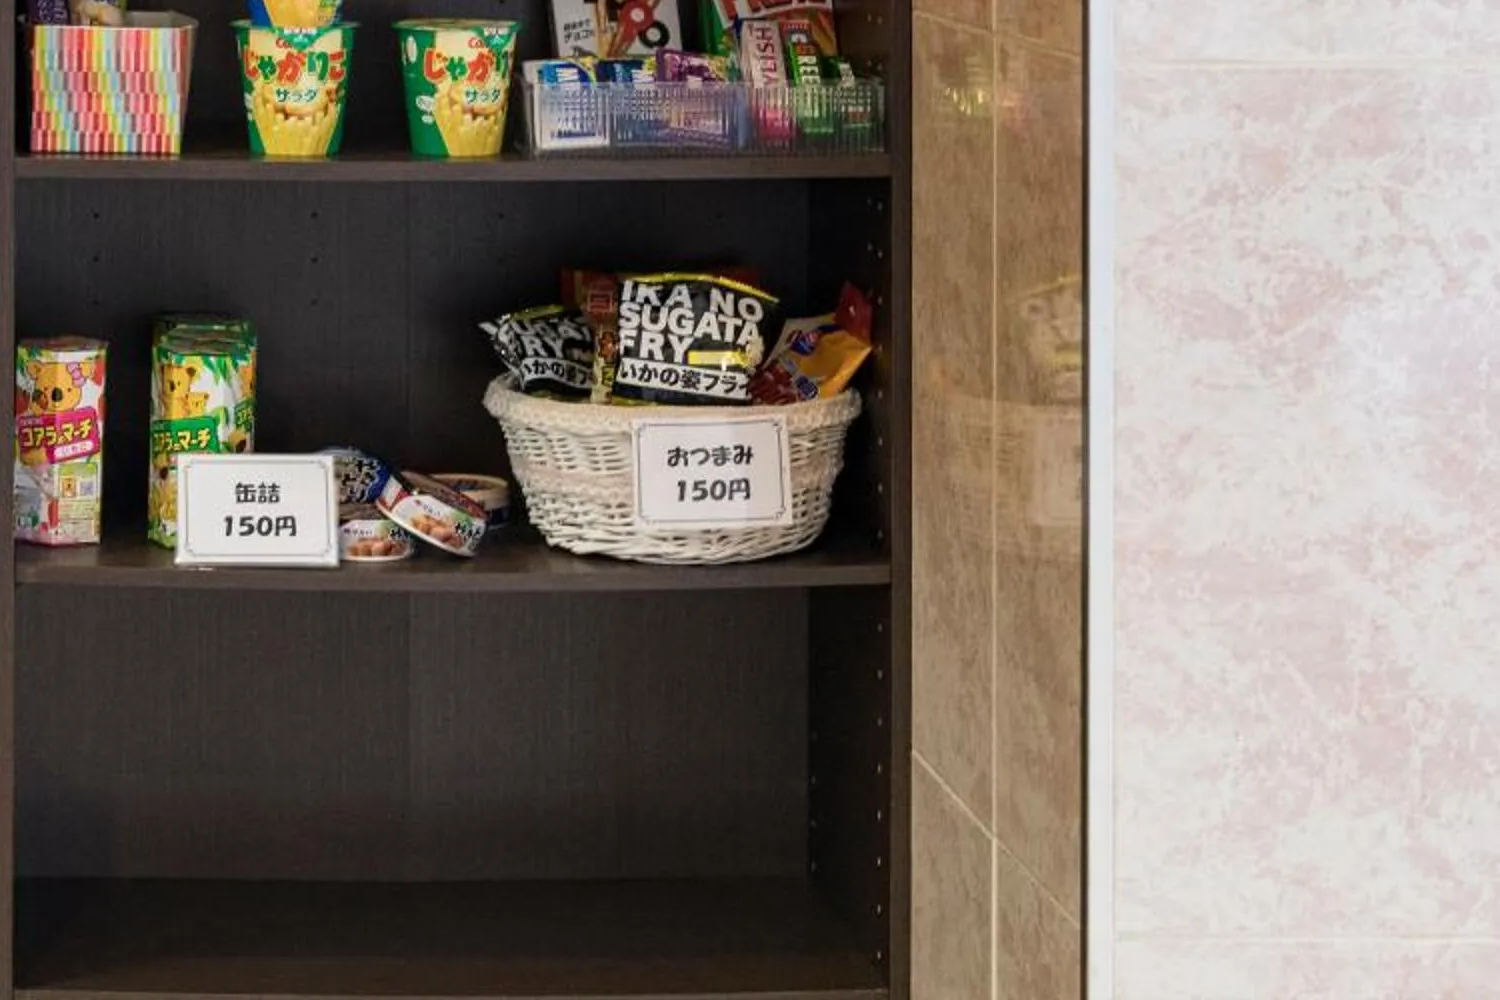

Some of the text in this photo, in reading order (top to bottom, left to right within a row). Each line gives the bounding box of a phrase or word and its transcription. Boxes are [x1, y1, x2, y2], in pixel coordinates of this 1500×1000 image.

[243, 49, 346, 82] じゃがりこ
[621, 280, 764, 323] IKA NO
[619, 302, 761, 346] SUGATA
[619, 328, 694, 365] FRY
[667, 445, 754, 467] おつまみ
[235, 482, 281, 503] 缶詰
[677, 478, 751, 501] 150円
[224, 515, 297, 537] 150円
